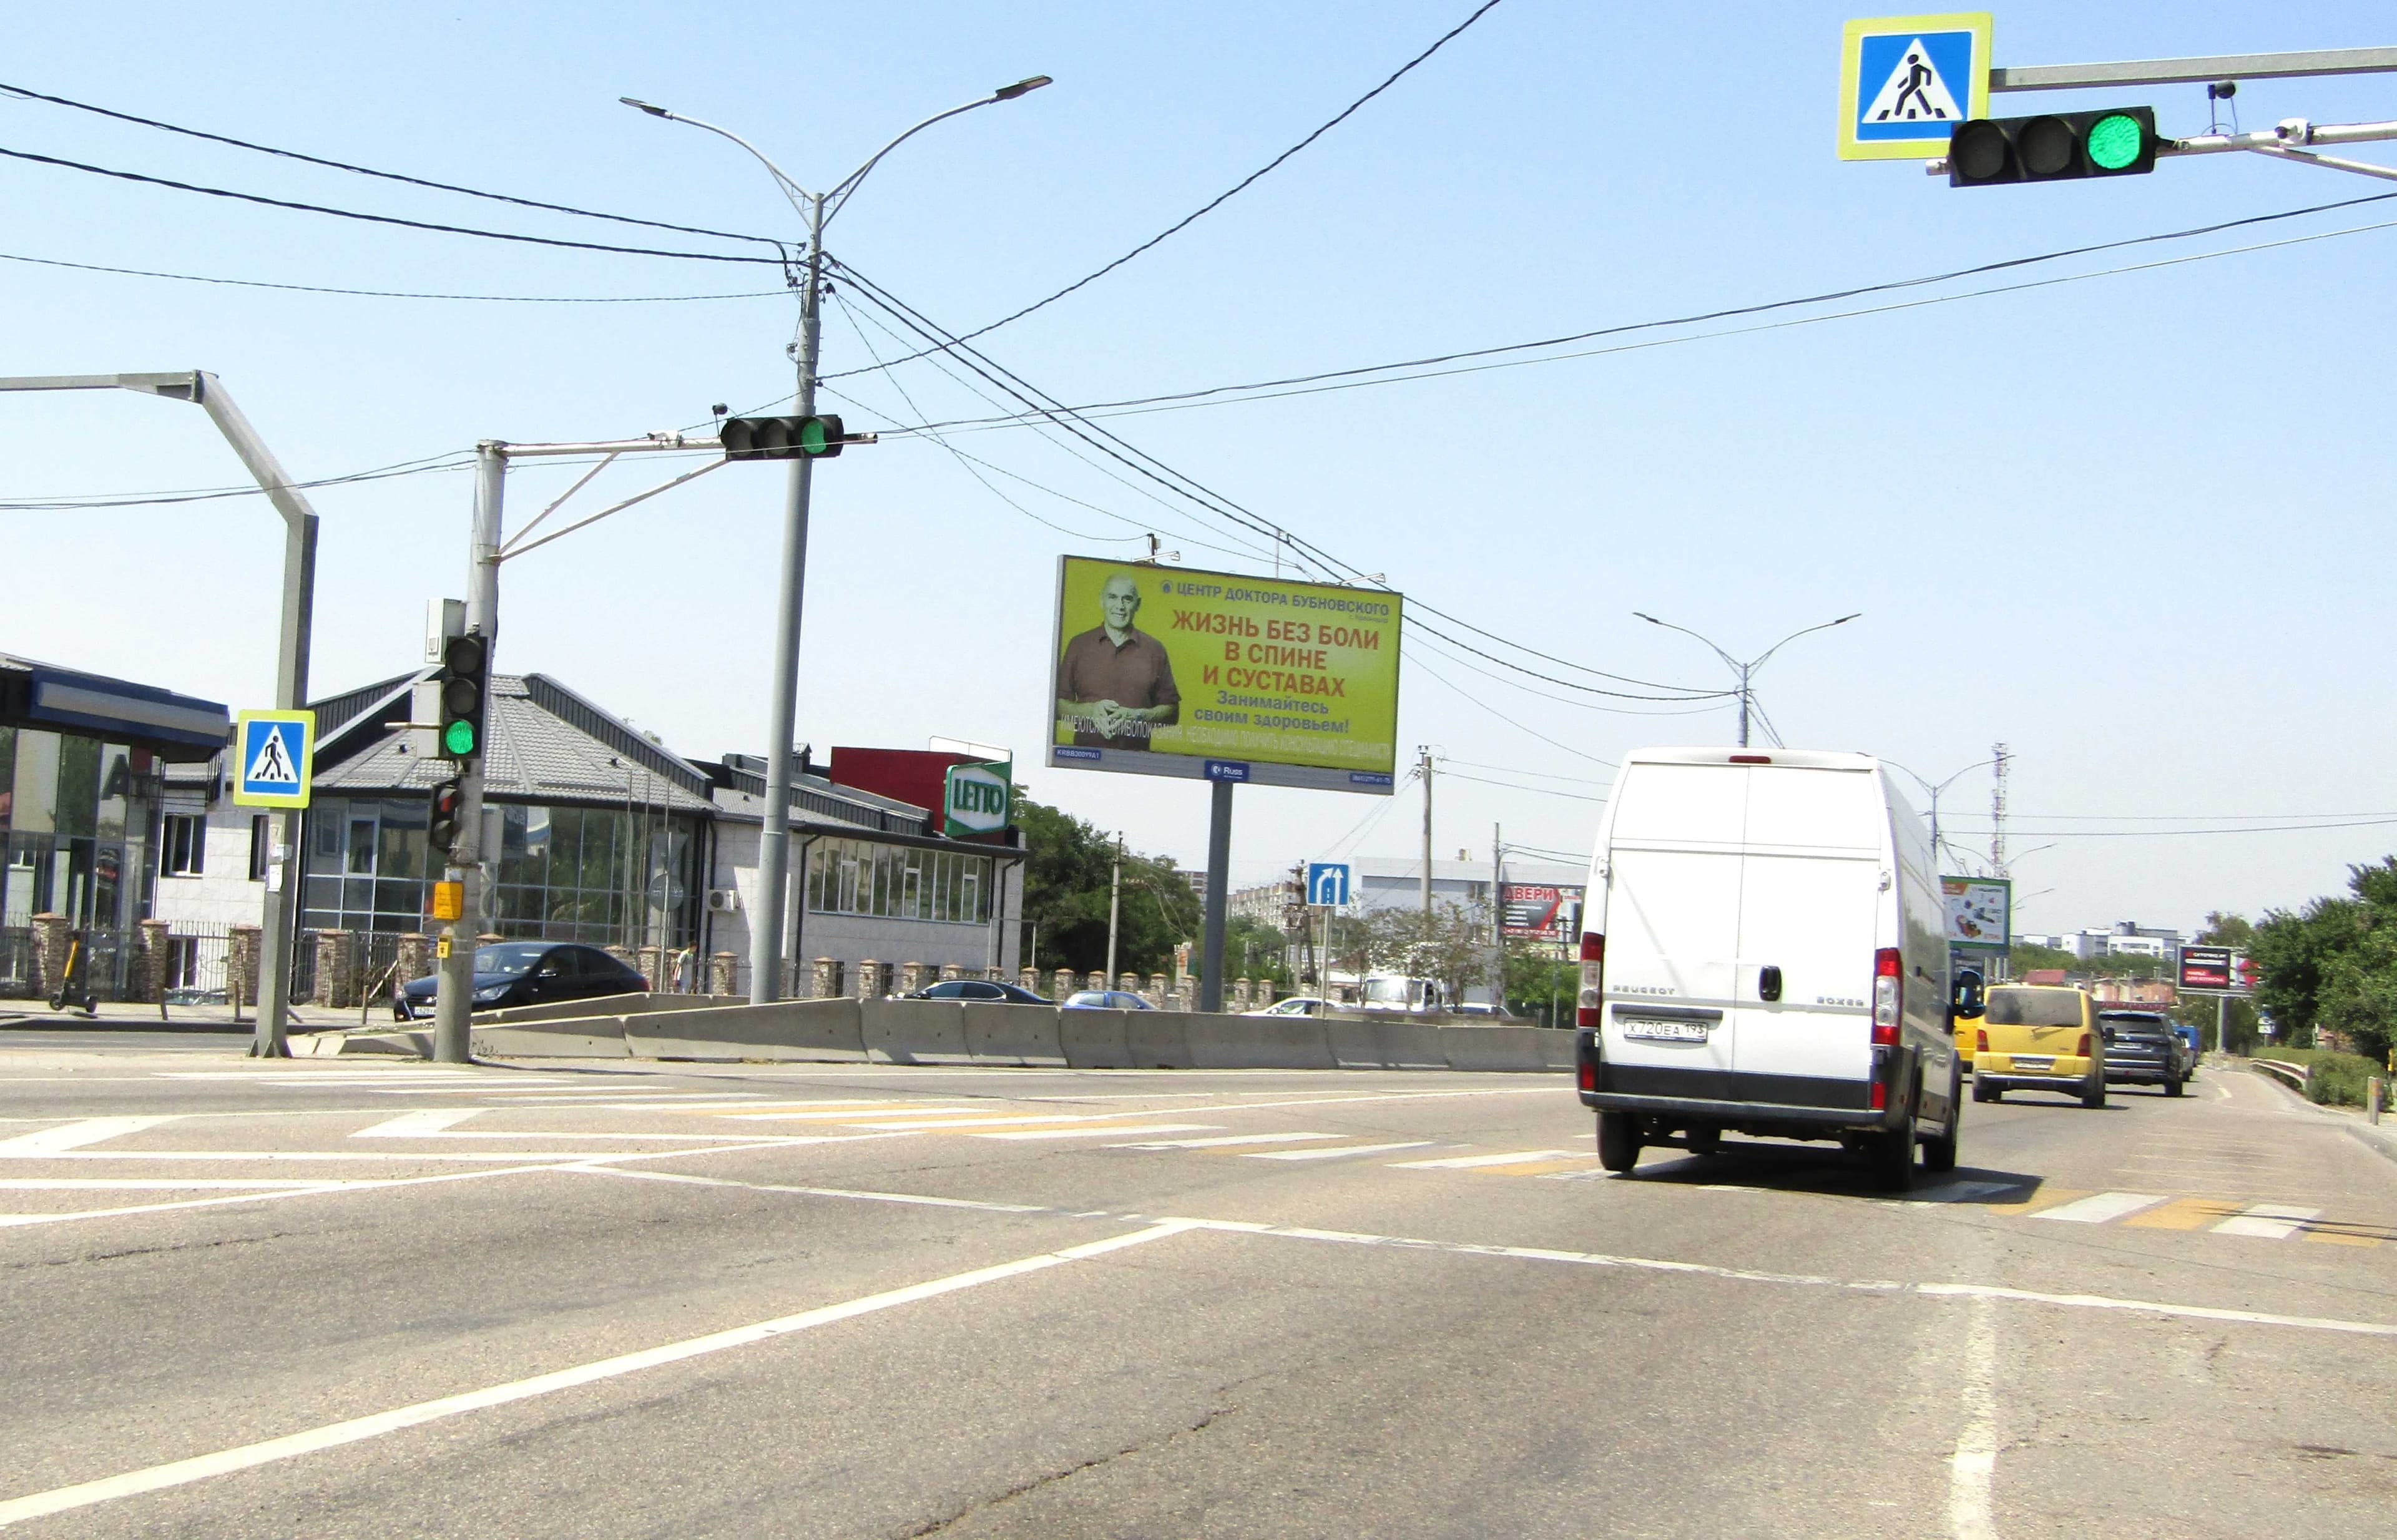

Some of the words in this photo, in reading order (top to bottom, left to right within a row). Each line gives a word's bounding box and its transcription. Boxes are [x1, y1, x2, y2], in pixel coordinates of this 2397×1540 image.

[1177, 582, 1222, 597] ЦЕНТР
[1225, 587, 1288, 606] ДОКТОРА
[1292, 594, 1390, 616] БУБНОВСКОГО
[1171, 609, 1260, 637] ЖИЗНЬ
[1267, 619, 1310, 643] БЕЗ
[1318, 625, 1380, 650] БОЛИ
[1225, 640, 1240, 661] В
[1248, 643, 1327, 670] СПИНЕ
[1203, 664, 1219, 685] И
[1227, 666, 1346, 697] СУСТАВАХ
[1217, 690, 1329, 714] Занимайтесь
[1194, 709, 1248, 723] своим
[1253, 714, 1349, 733] здоровьем!
[1223, 766, 1243, 776] Russ
[954, 778, 1005, 814] LETTO
[1504, 886, 1553, 902] ДВЕРИ
[1613, 985, 1675, 995] PEUGEOT
